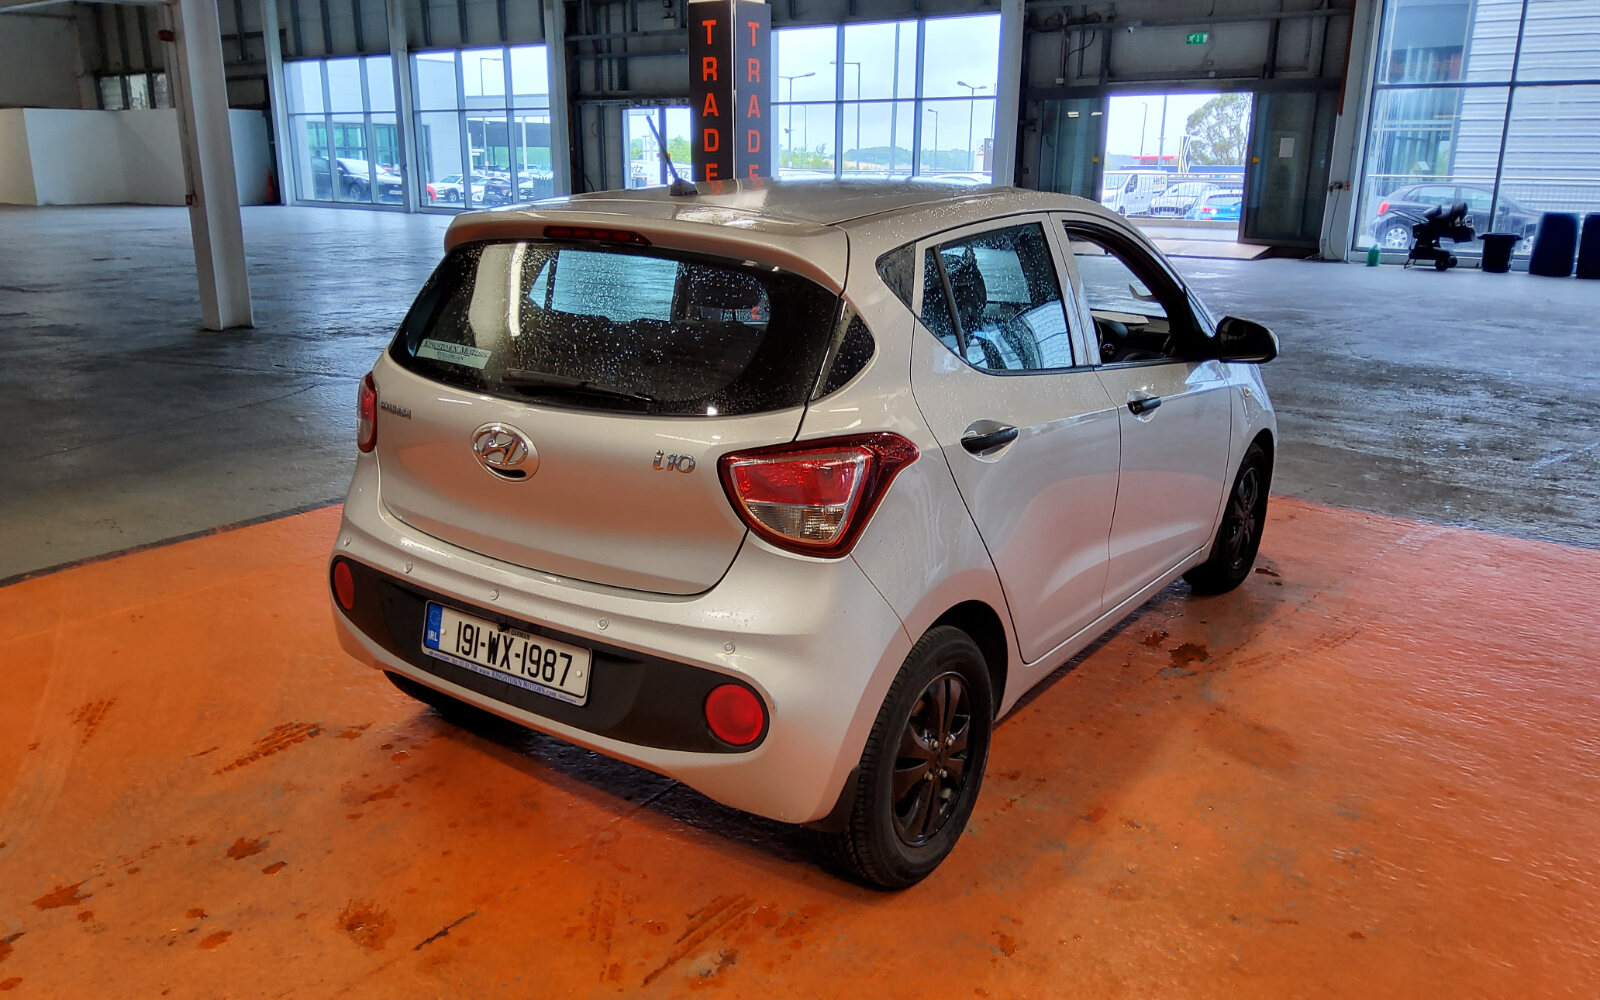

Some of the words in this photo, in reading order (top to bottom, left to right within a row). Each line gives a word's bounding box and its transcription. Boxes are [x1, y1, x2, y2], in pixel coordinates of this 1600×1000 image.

[652, 449, 696, 473] i10
[427, 629, 438, 642] IRL
[456, 620, 573, 687] 191-WX-1987
